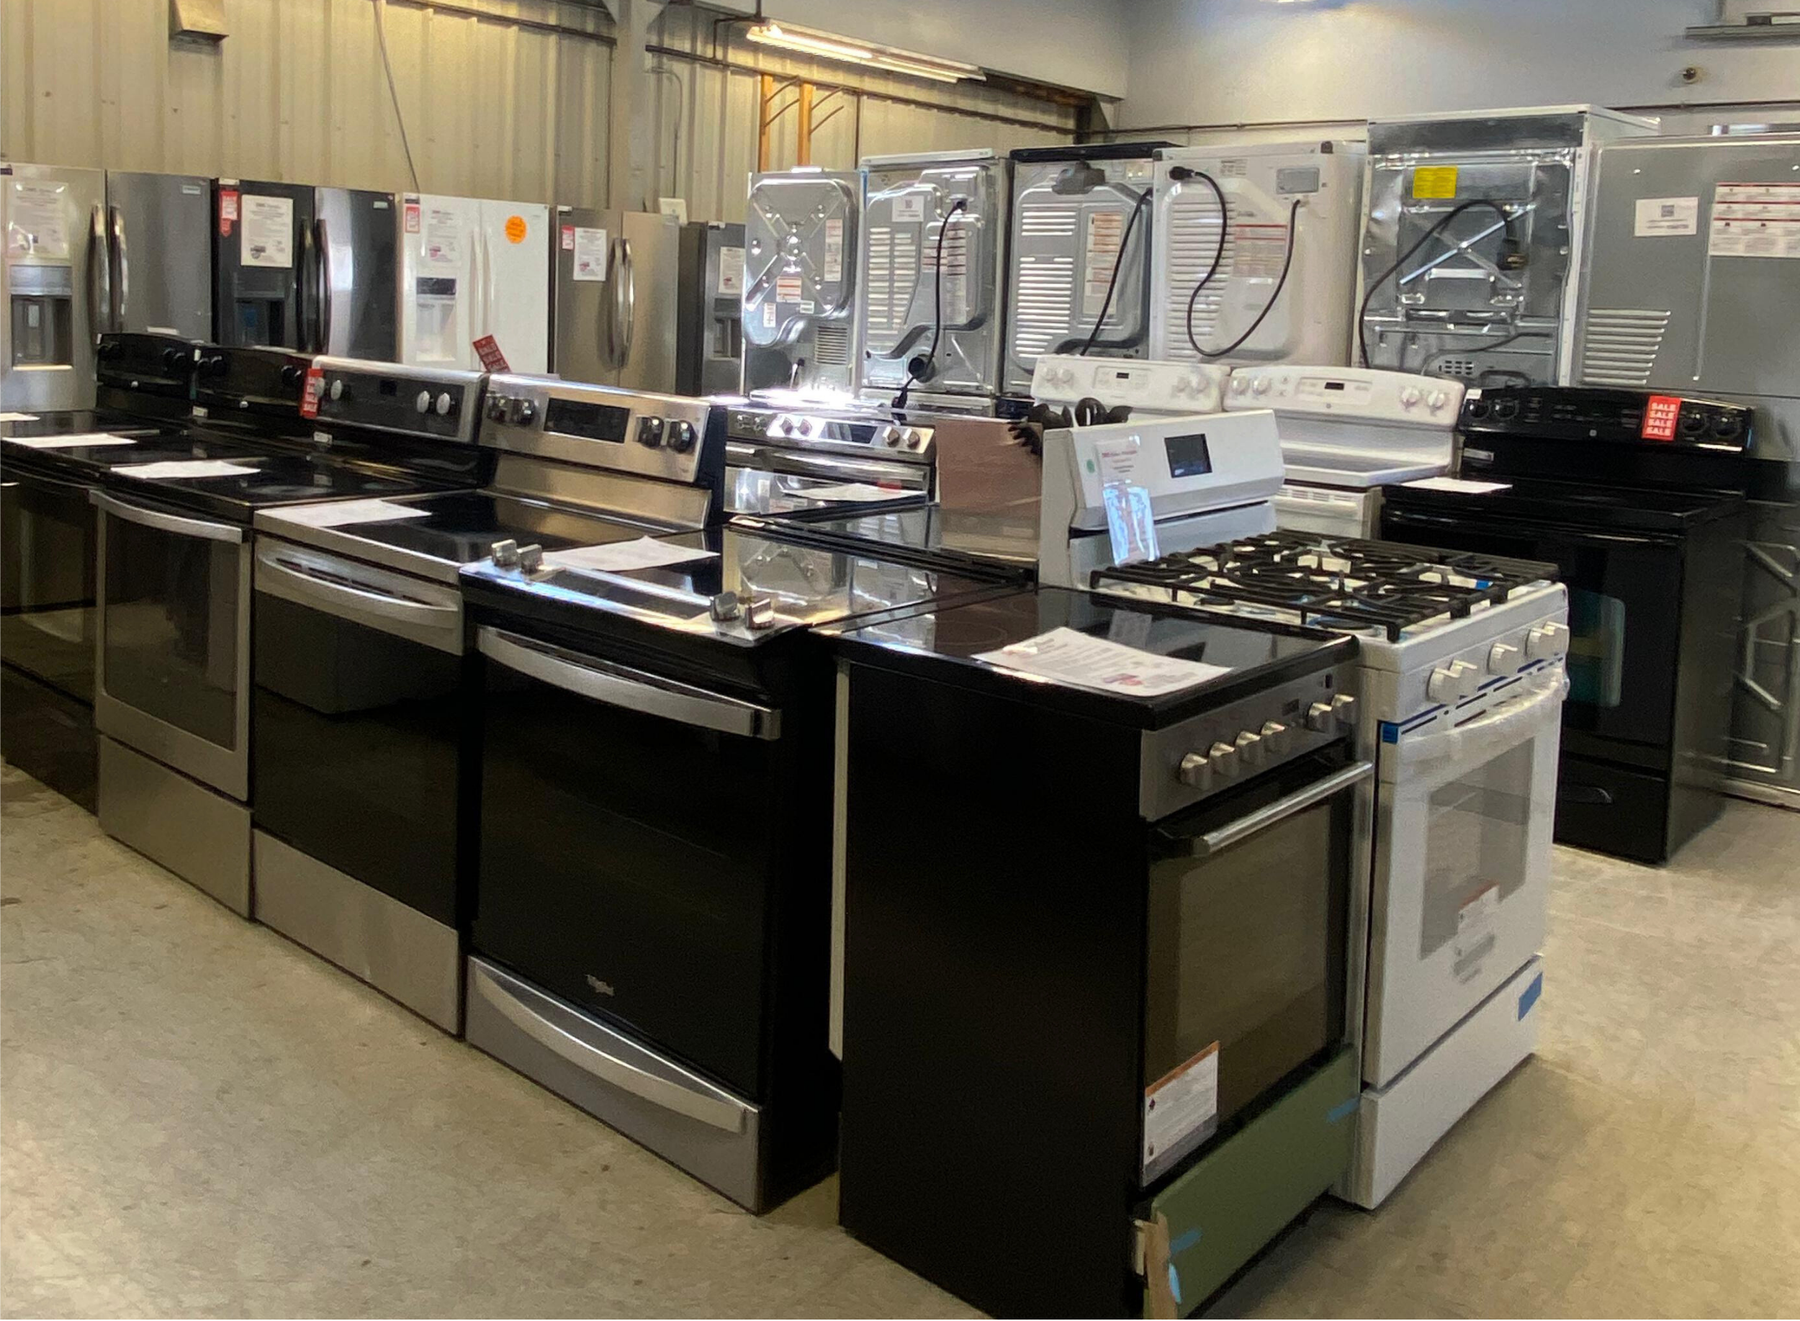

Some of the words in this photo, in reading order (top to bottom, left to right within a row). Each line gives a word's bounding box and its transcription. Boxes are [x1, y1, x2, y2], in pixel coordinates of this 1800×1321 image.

[1651, 402, 1676, 411] SALE
[1650, 410, 1674, 419] SALE
[1648, 418, 1672, 428] SALE
[1646, 427, 1671, 436] SALE
